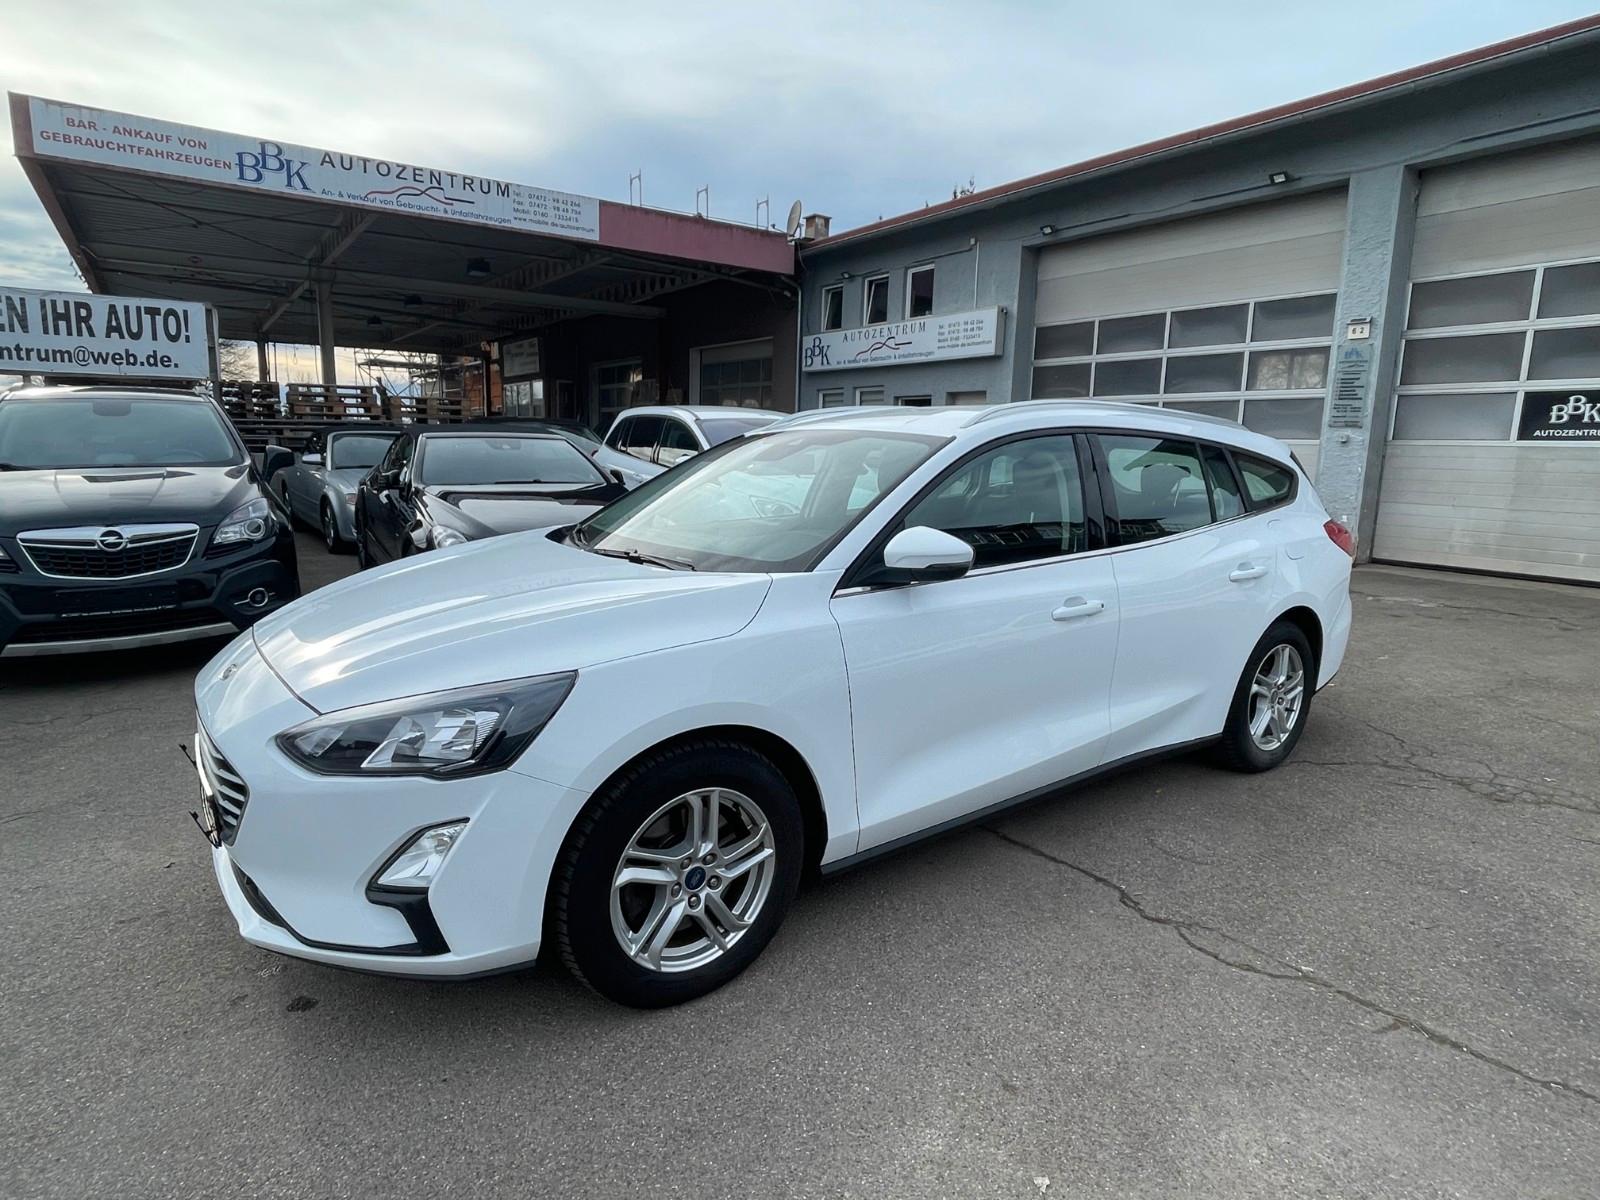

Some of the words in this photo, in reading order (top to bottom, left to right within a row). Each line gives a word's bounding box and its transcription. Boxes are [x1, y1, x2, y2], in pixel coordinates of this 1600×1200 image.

[39, 130, 232, 170] GEBRAUCHTFAHRZEUGEN
[65, 116, 97, 132] BAR
[112, 125, 173, 144] ANKAUF
[178, 136, 208, 150] VON
[235, 141, 314, 192] BBK
[320, 151, 510, 198] AUTOZENTRUM
[39, 298, 96, 338] IHR
[105, 303, 191, 344] AUTO!
[842, 321, 926, 343] AUTOZENTRUM
[804, 336, 832, 367] BBK
[1548, 395, 1600, 424] BBK
